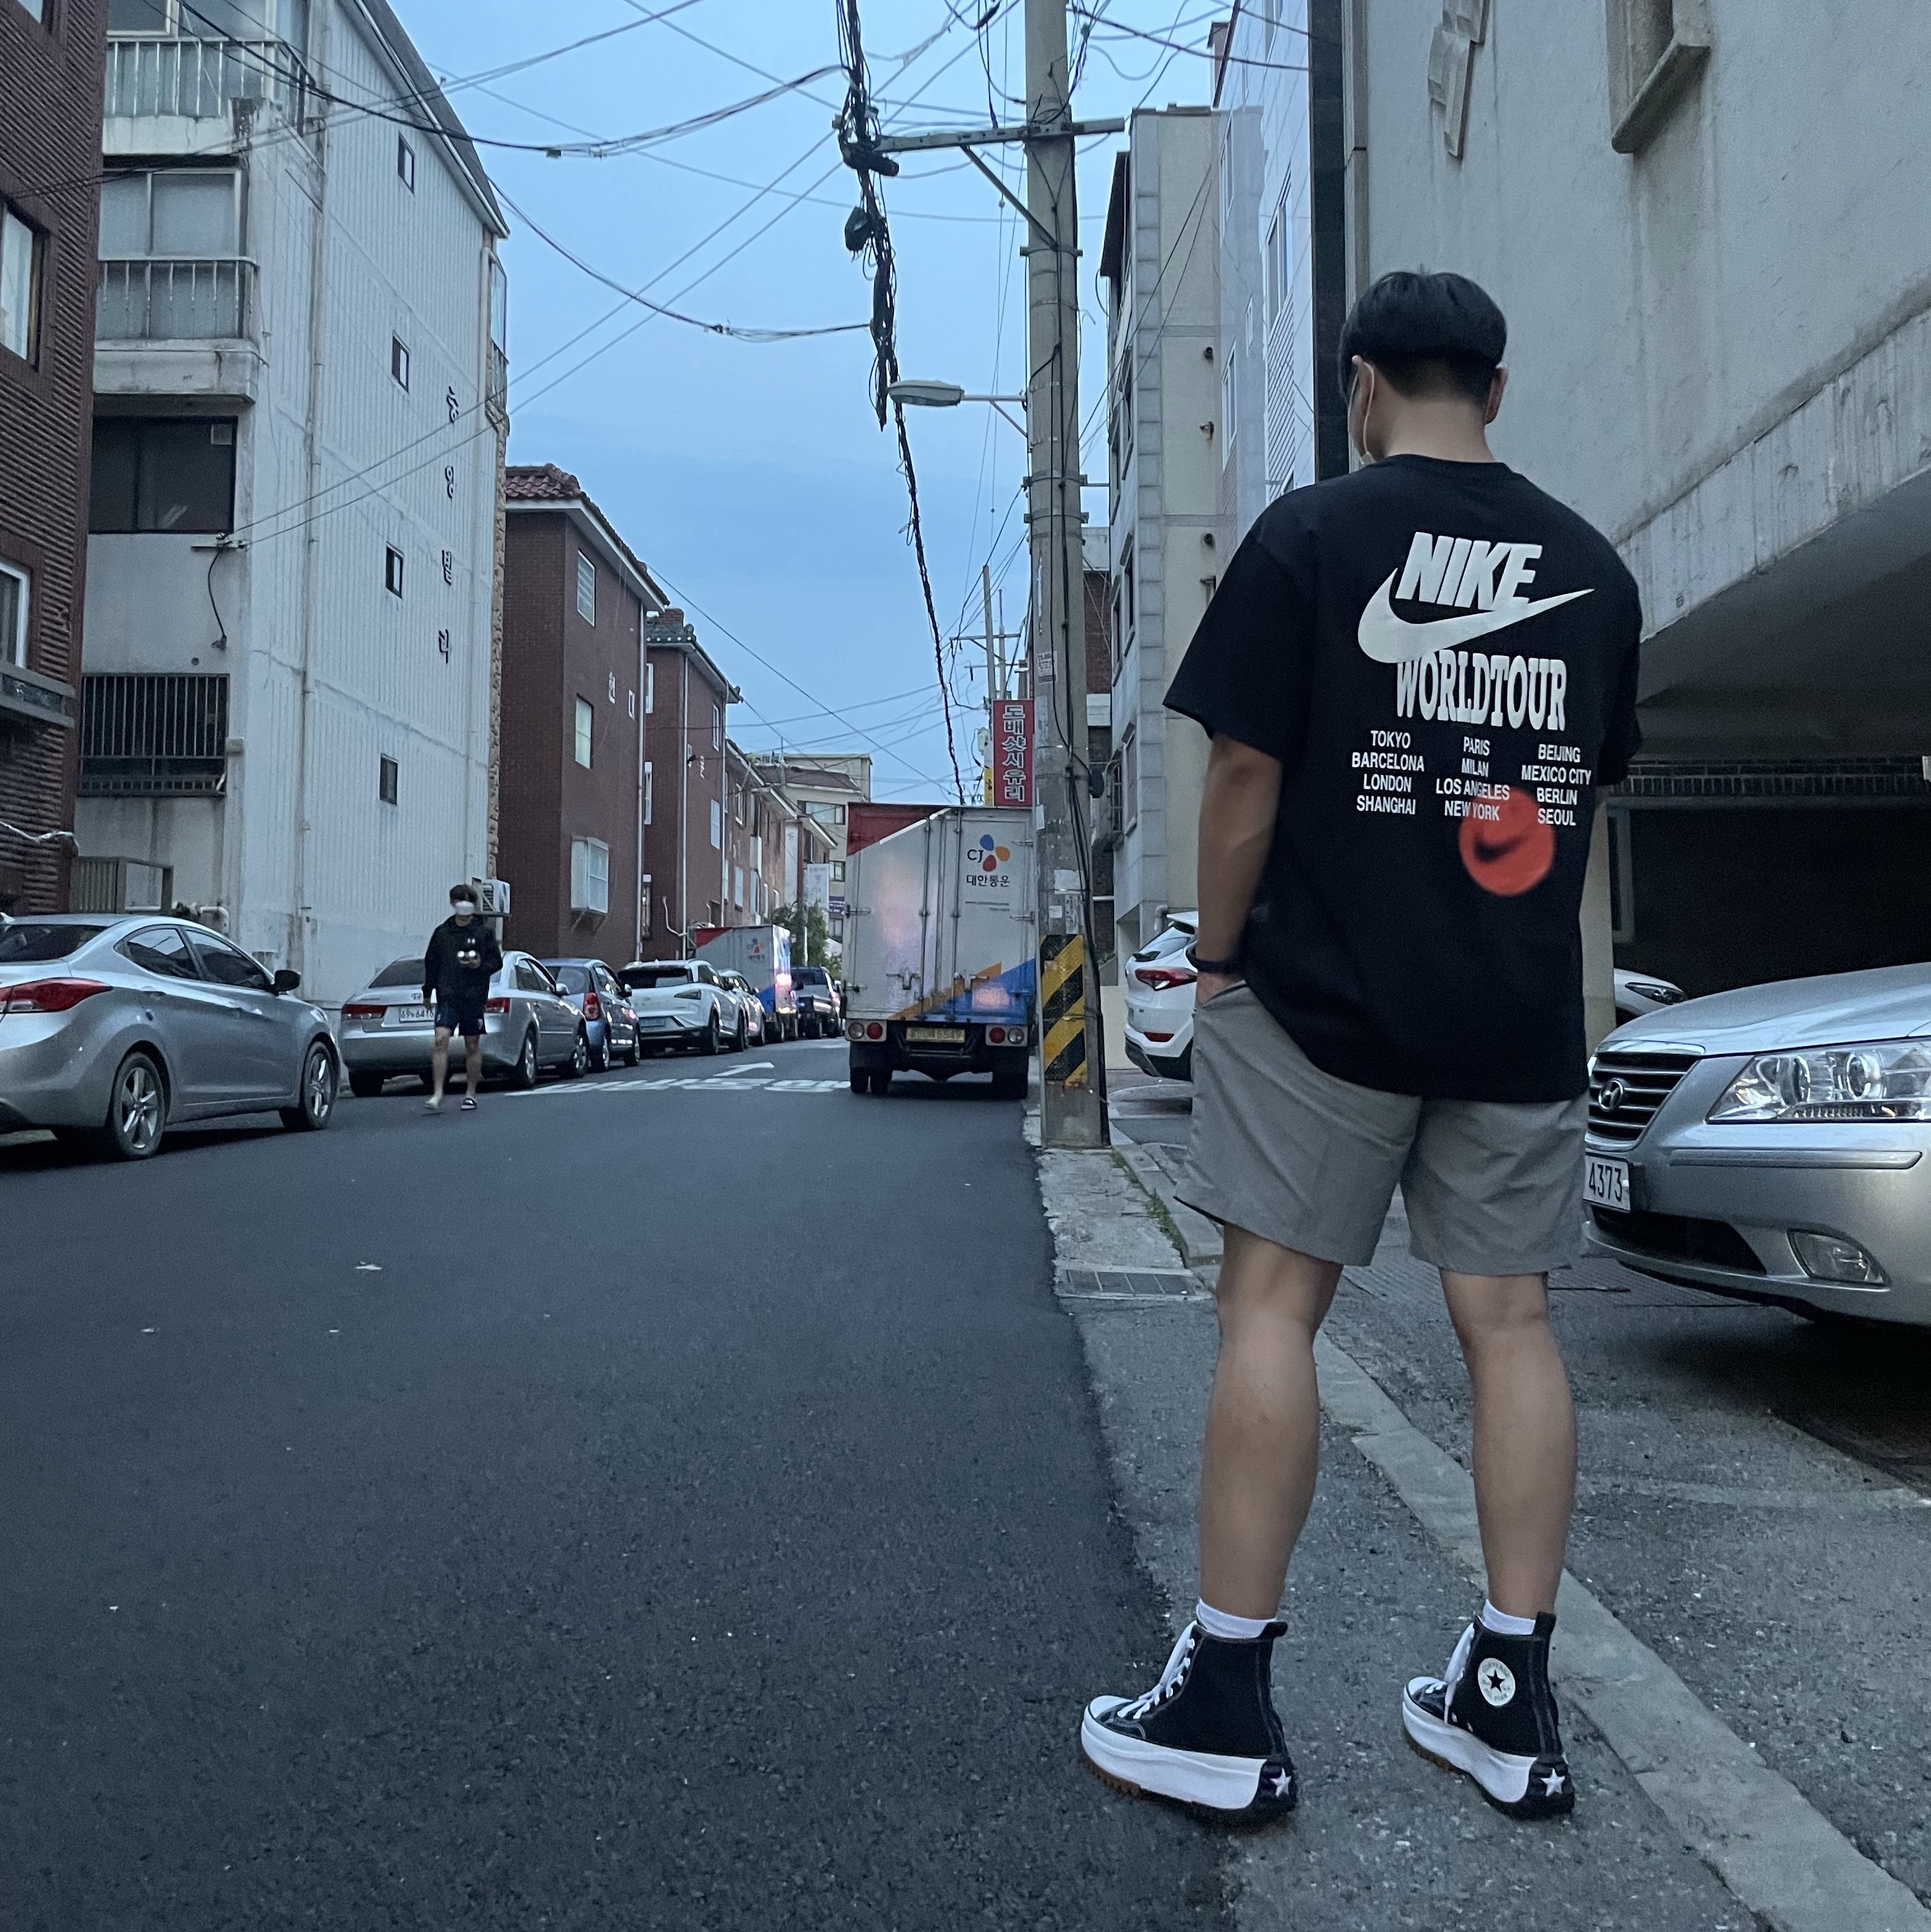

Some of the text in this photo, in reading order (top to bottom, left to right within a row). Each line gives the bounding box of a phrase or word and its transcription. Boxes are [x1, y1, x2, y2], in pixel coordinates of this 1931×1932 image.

[1395, 531, 1543, 611] NIKE
[1371, 731, 1411, 749] TOKYO
[1463, 736, 1490, 756] PARIS
[1002, 704, 1027, 802] 도배샷시유리
[1352, 752, 1425, 772] BARCELONA
[1538, 744, 1580, 763] BEIJING
[1461, 758, 1489, 778] MILAN
[1522, 764, 1591, 786] MEXICO CITY
[1364, 774, 1412, 793] LONDON
[1436, 778, 1510, 801] LOS ANGELES
[1357, 795, 1416, 815] SHANGHAI
[1536, 787, 1577, 805] BERLIN
[1444, 800, 1500, 821] NEW YORK
[1538, 808, 1577, 826] SEOUL
[967, 849, 984, 863] CJ
[1589, 1162, 1623, 1202] 4373
